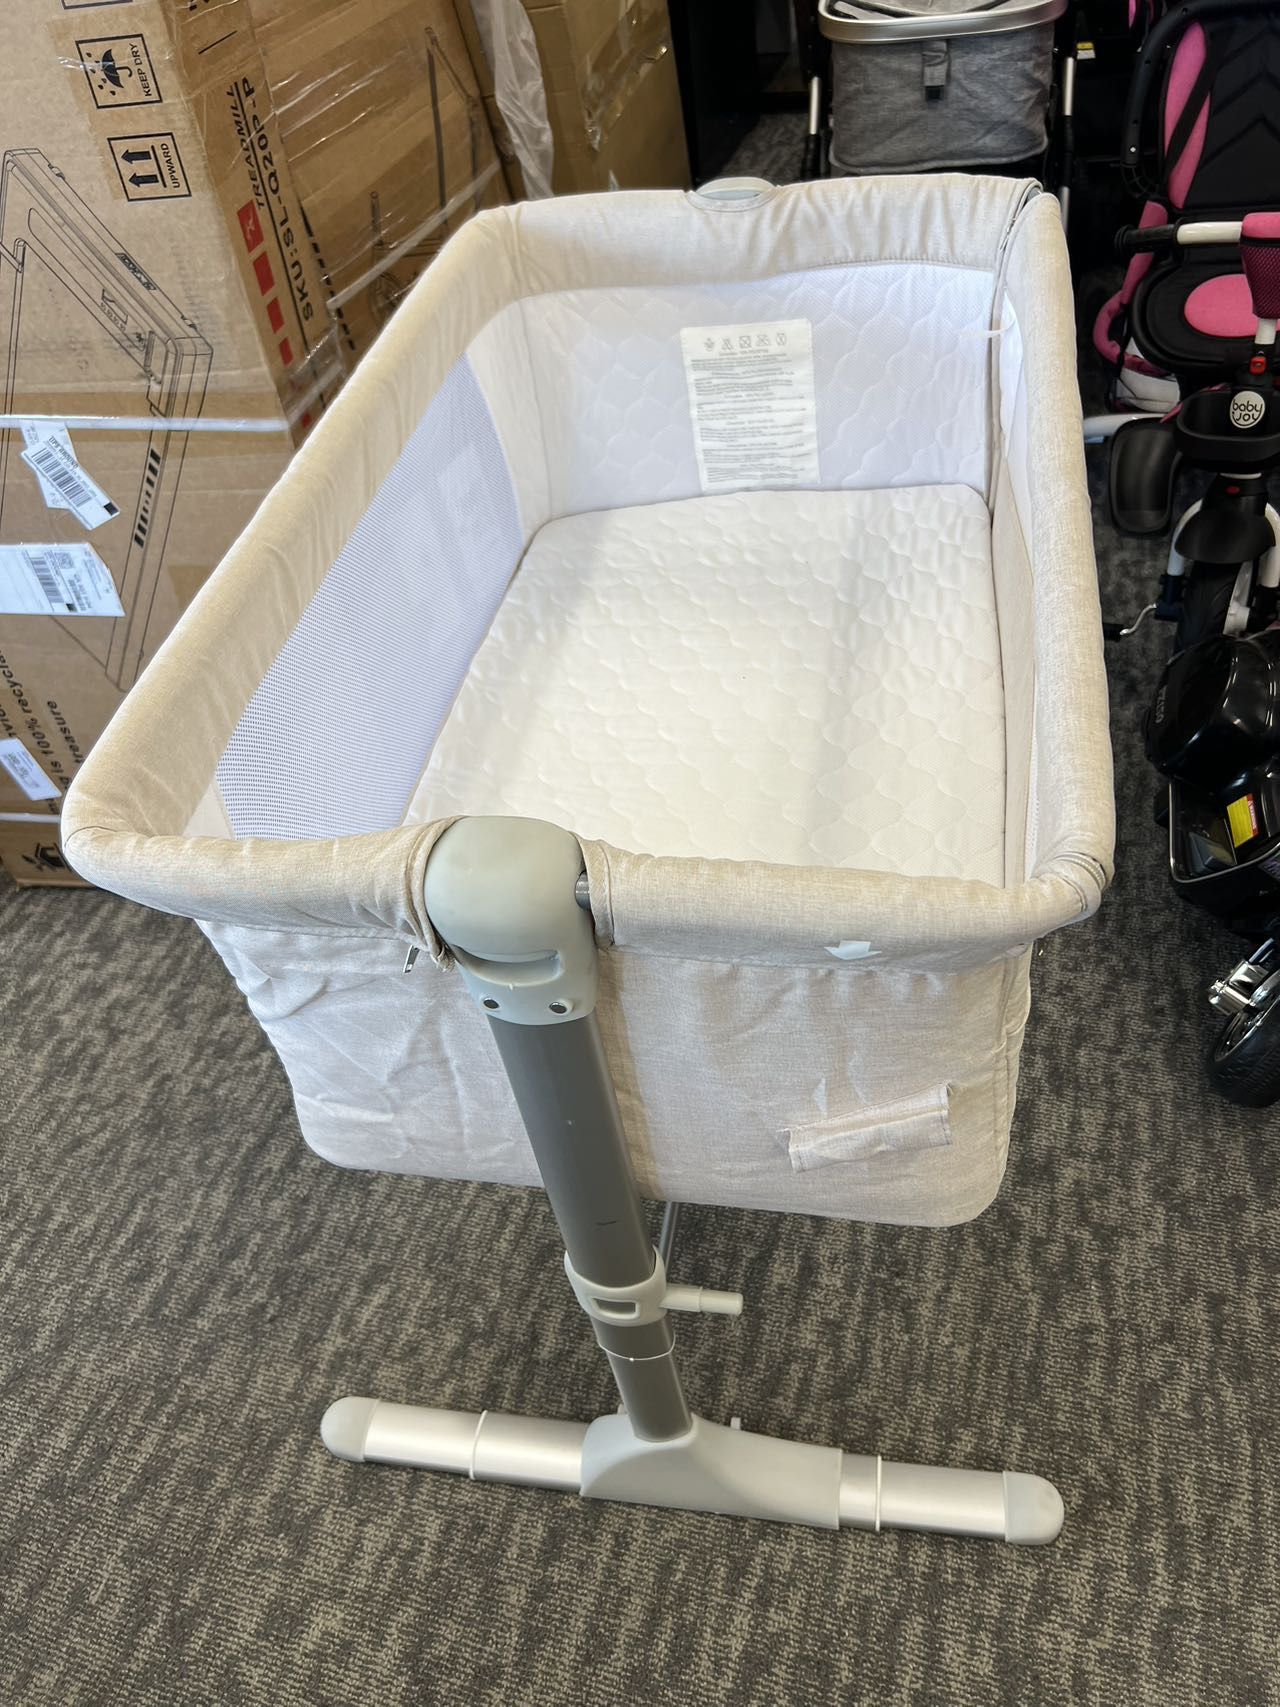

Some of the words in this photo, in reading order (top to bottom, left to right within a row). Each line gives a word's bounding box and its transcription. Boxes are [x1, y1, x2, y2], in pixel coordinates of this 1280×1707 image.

[129, 43, 143, 65] DRY
[138, 68, 153, 97] KEEP
[161, 142, 180, 189] UPWARD
[226, 88, 266, 210] TREADMILL
[1232, 398, 1263, 412] baby
[0, 648, 33, 715] recycla
[26, 717, 54, 757] 100%
[46, 699, 84, 764] treasure
[51, 759, 65, 774] is
